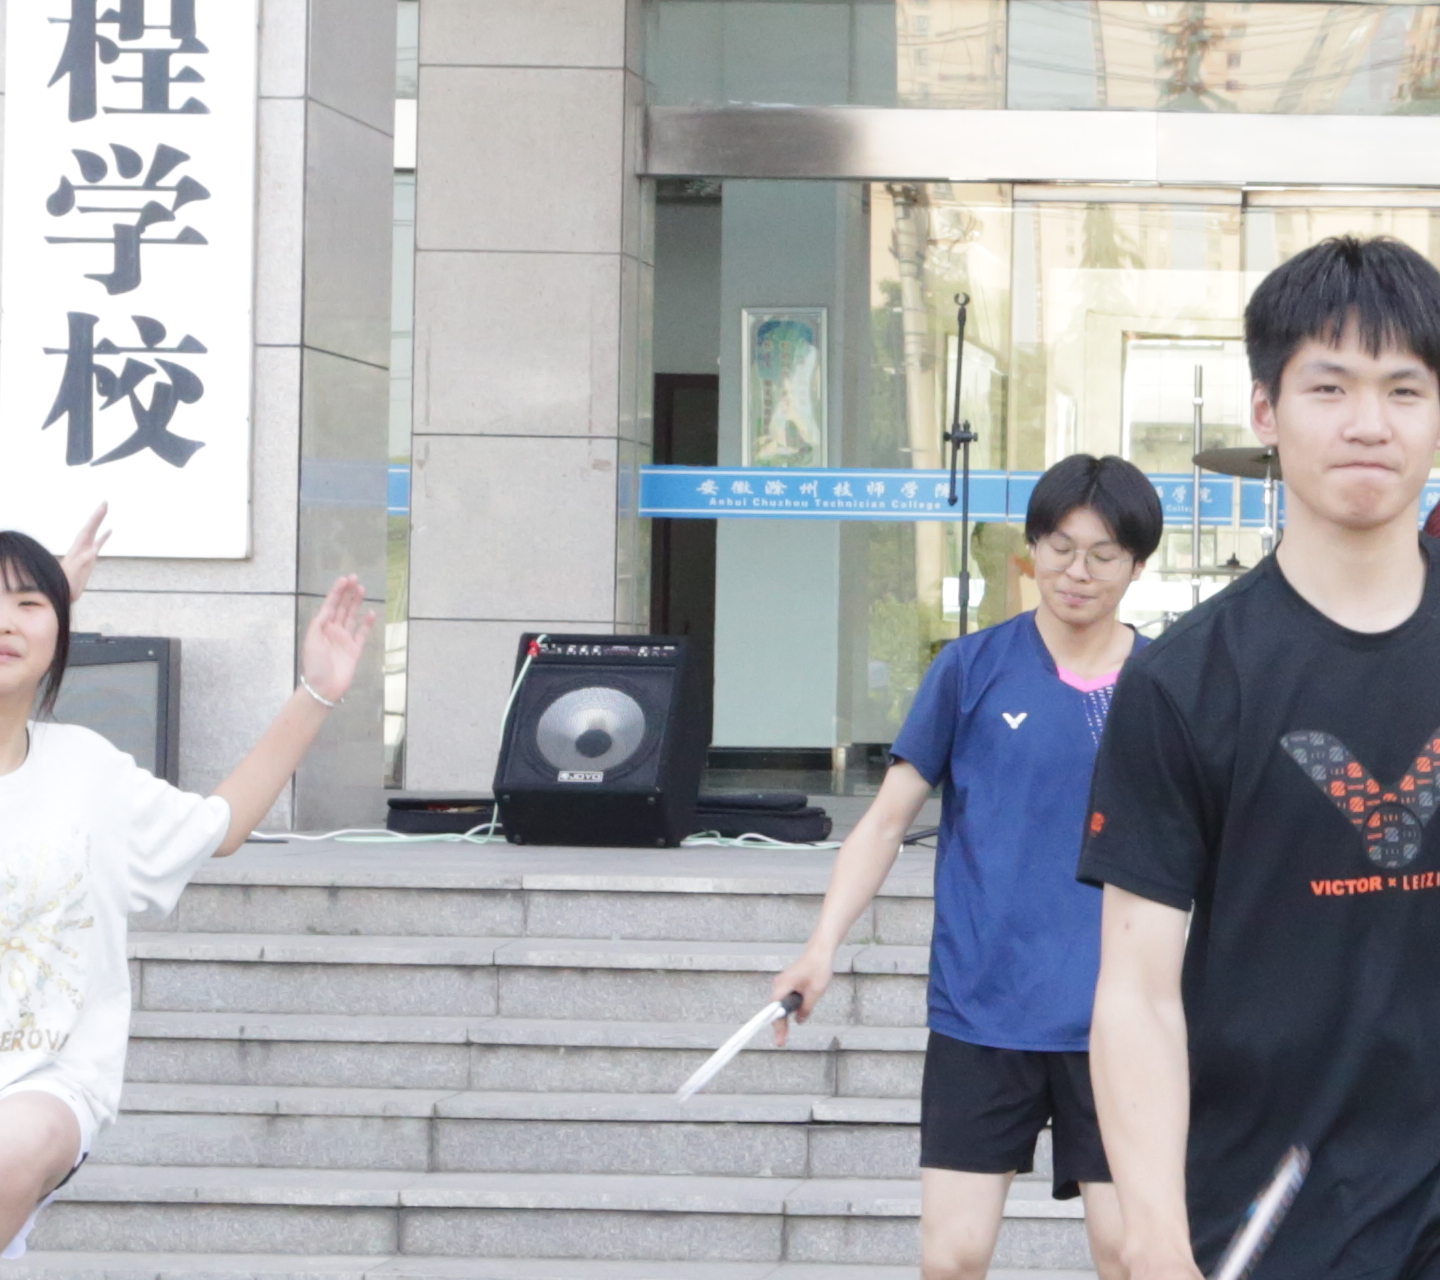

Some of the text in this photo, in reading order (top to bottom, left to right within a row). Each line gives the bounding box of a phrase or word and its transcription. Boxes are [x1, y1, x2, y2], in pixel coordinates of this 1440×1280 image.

[710, 497, 941, 511] Anhui Chuzhou Technician College
[1310, 875, 1383, 896] VICTOR
